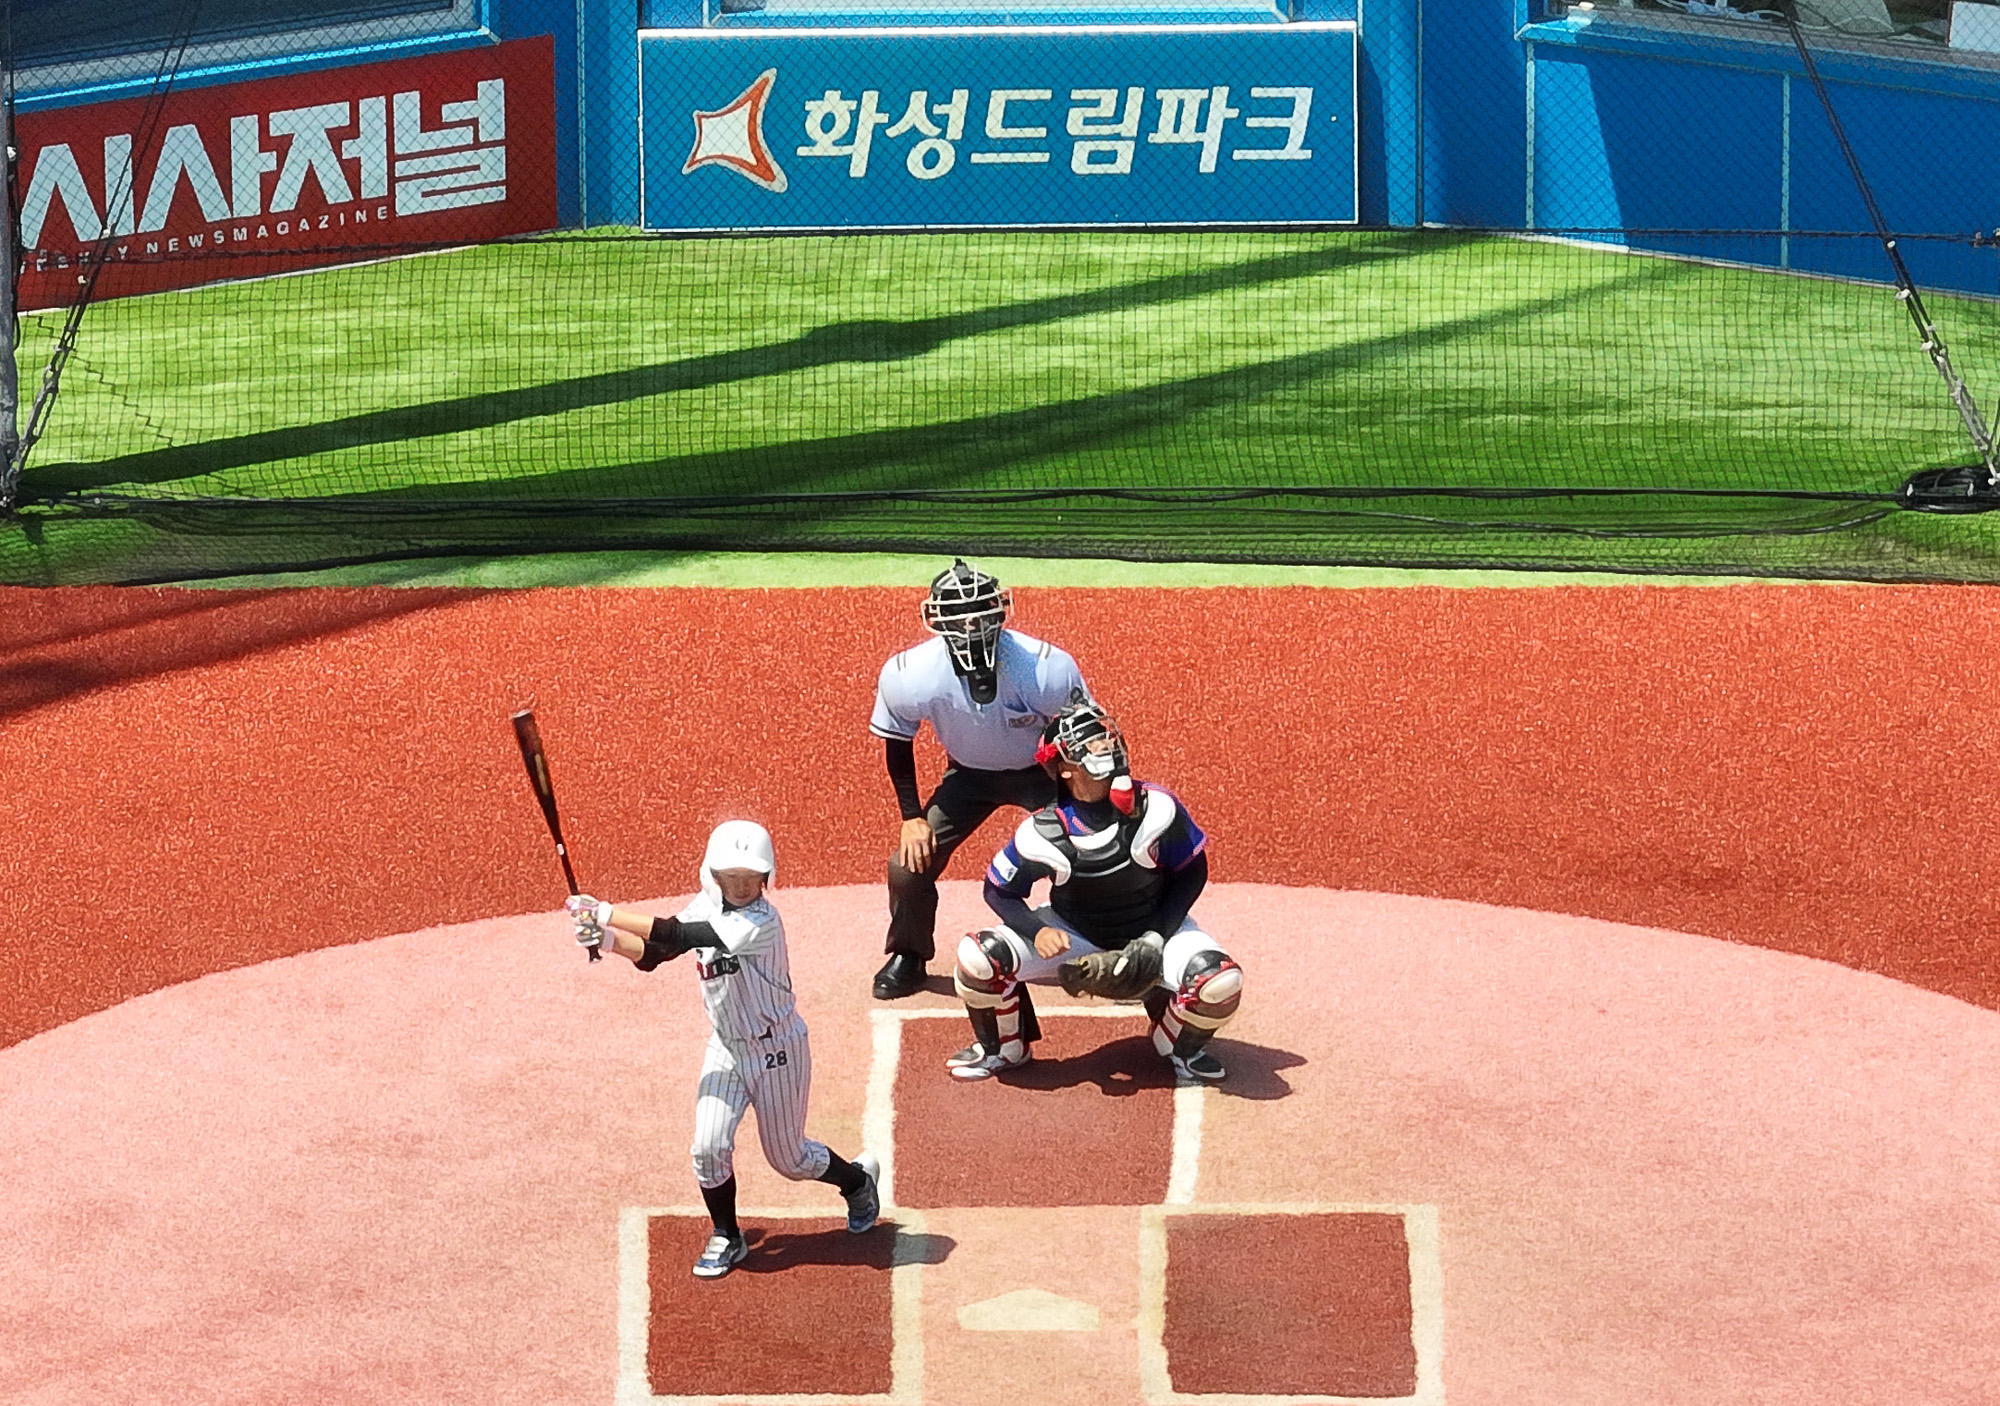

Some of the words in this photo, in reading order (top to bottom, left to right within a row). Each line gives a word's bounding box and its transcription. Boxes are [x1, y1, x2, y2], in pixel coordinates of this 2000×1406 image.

[20, 78, 507, 250] 시사저널
[796, 85, 1314, 181] 화성드림파크
[146, 205, 389, 255] NEWSMAGAZINE
[764, 1050, 788, 1070] 28
